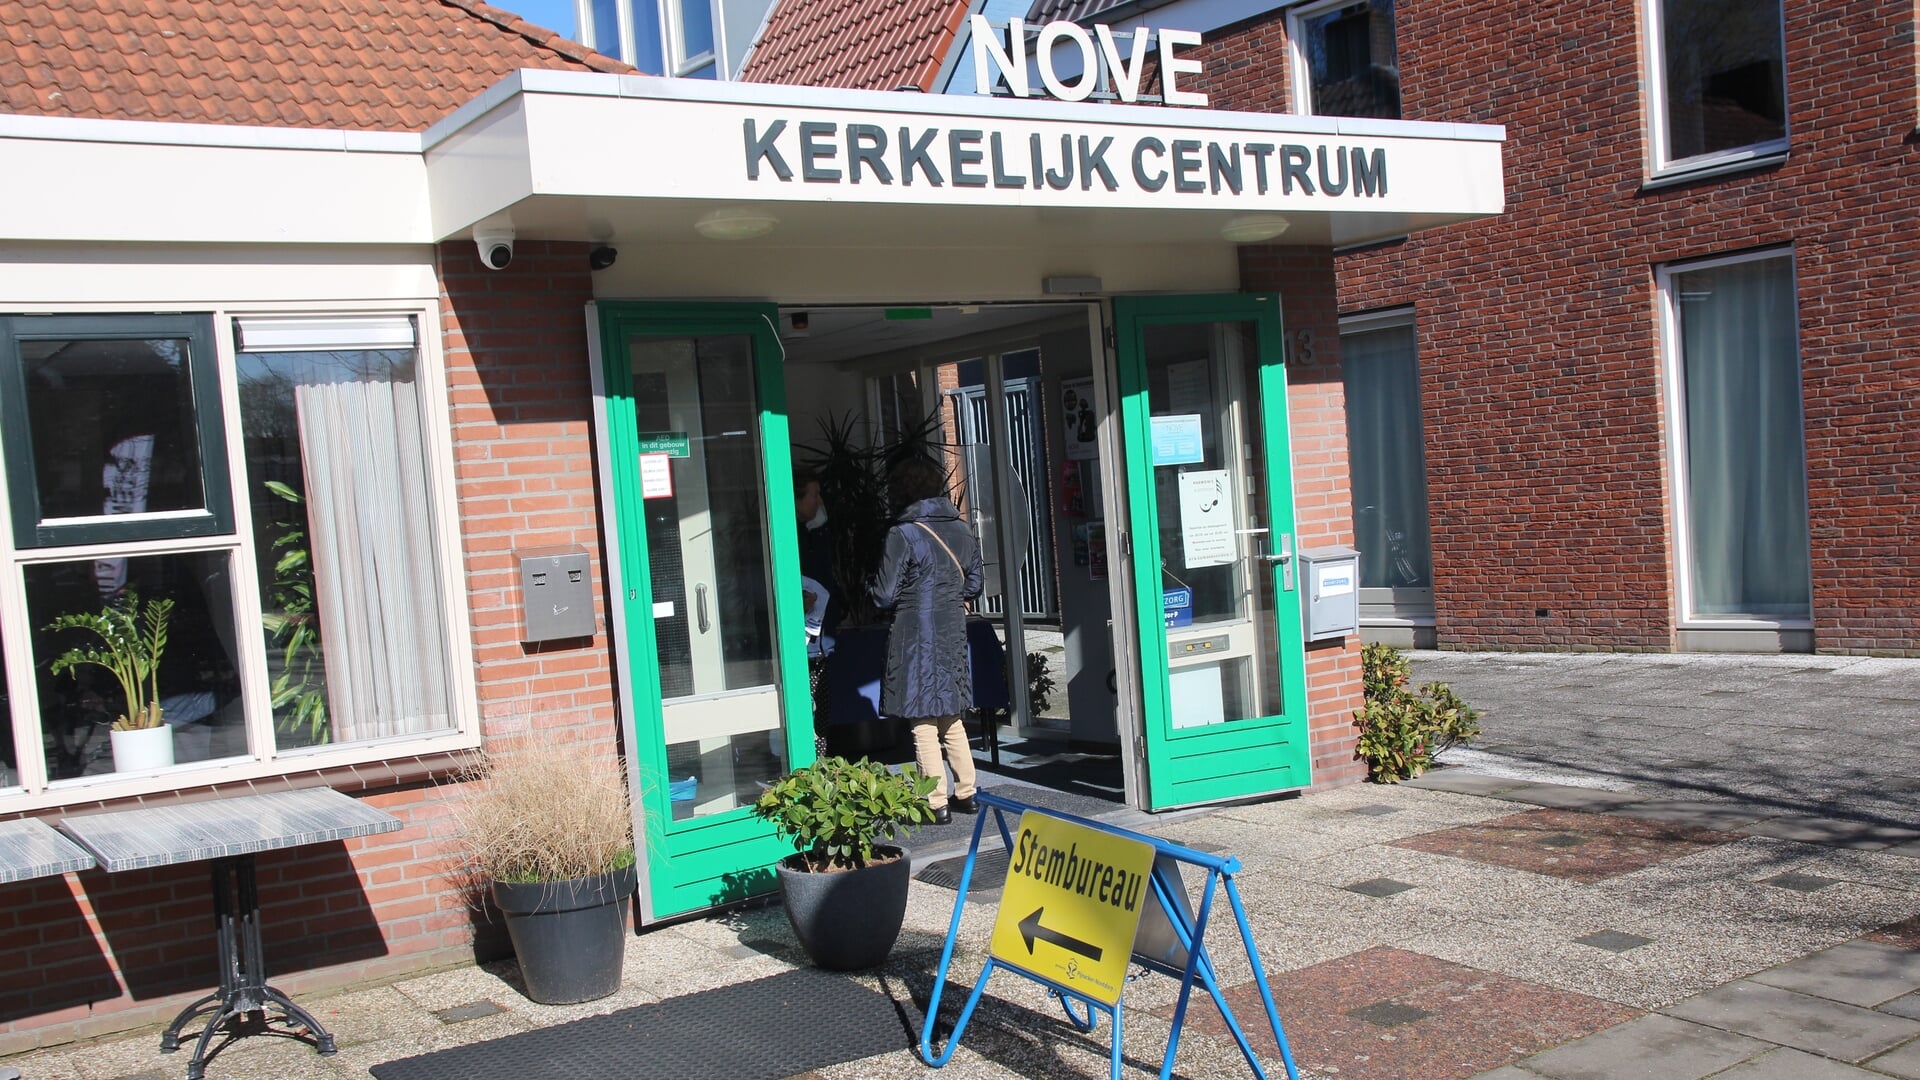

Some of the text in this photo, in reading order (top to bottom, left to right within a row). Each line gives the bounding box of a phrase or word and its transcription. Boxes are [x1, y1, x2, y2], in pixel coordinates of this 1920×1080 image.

[971, 14, 1208, 106] NOVE
[743, 118, 1389, 199] KERKELIJK CENTRUM
[1285, 328, 1314, 366] 13
[659, 441, 685, 449] gebouw
[1013, 828, 1141, 912] Stembureau
